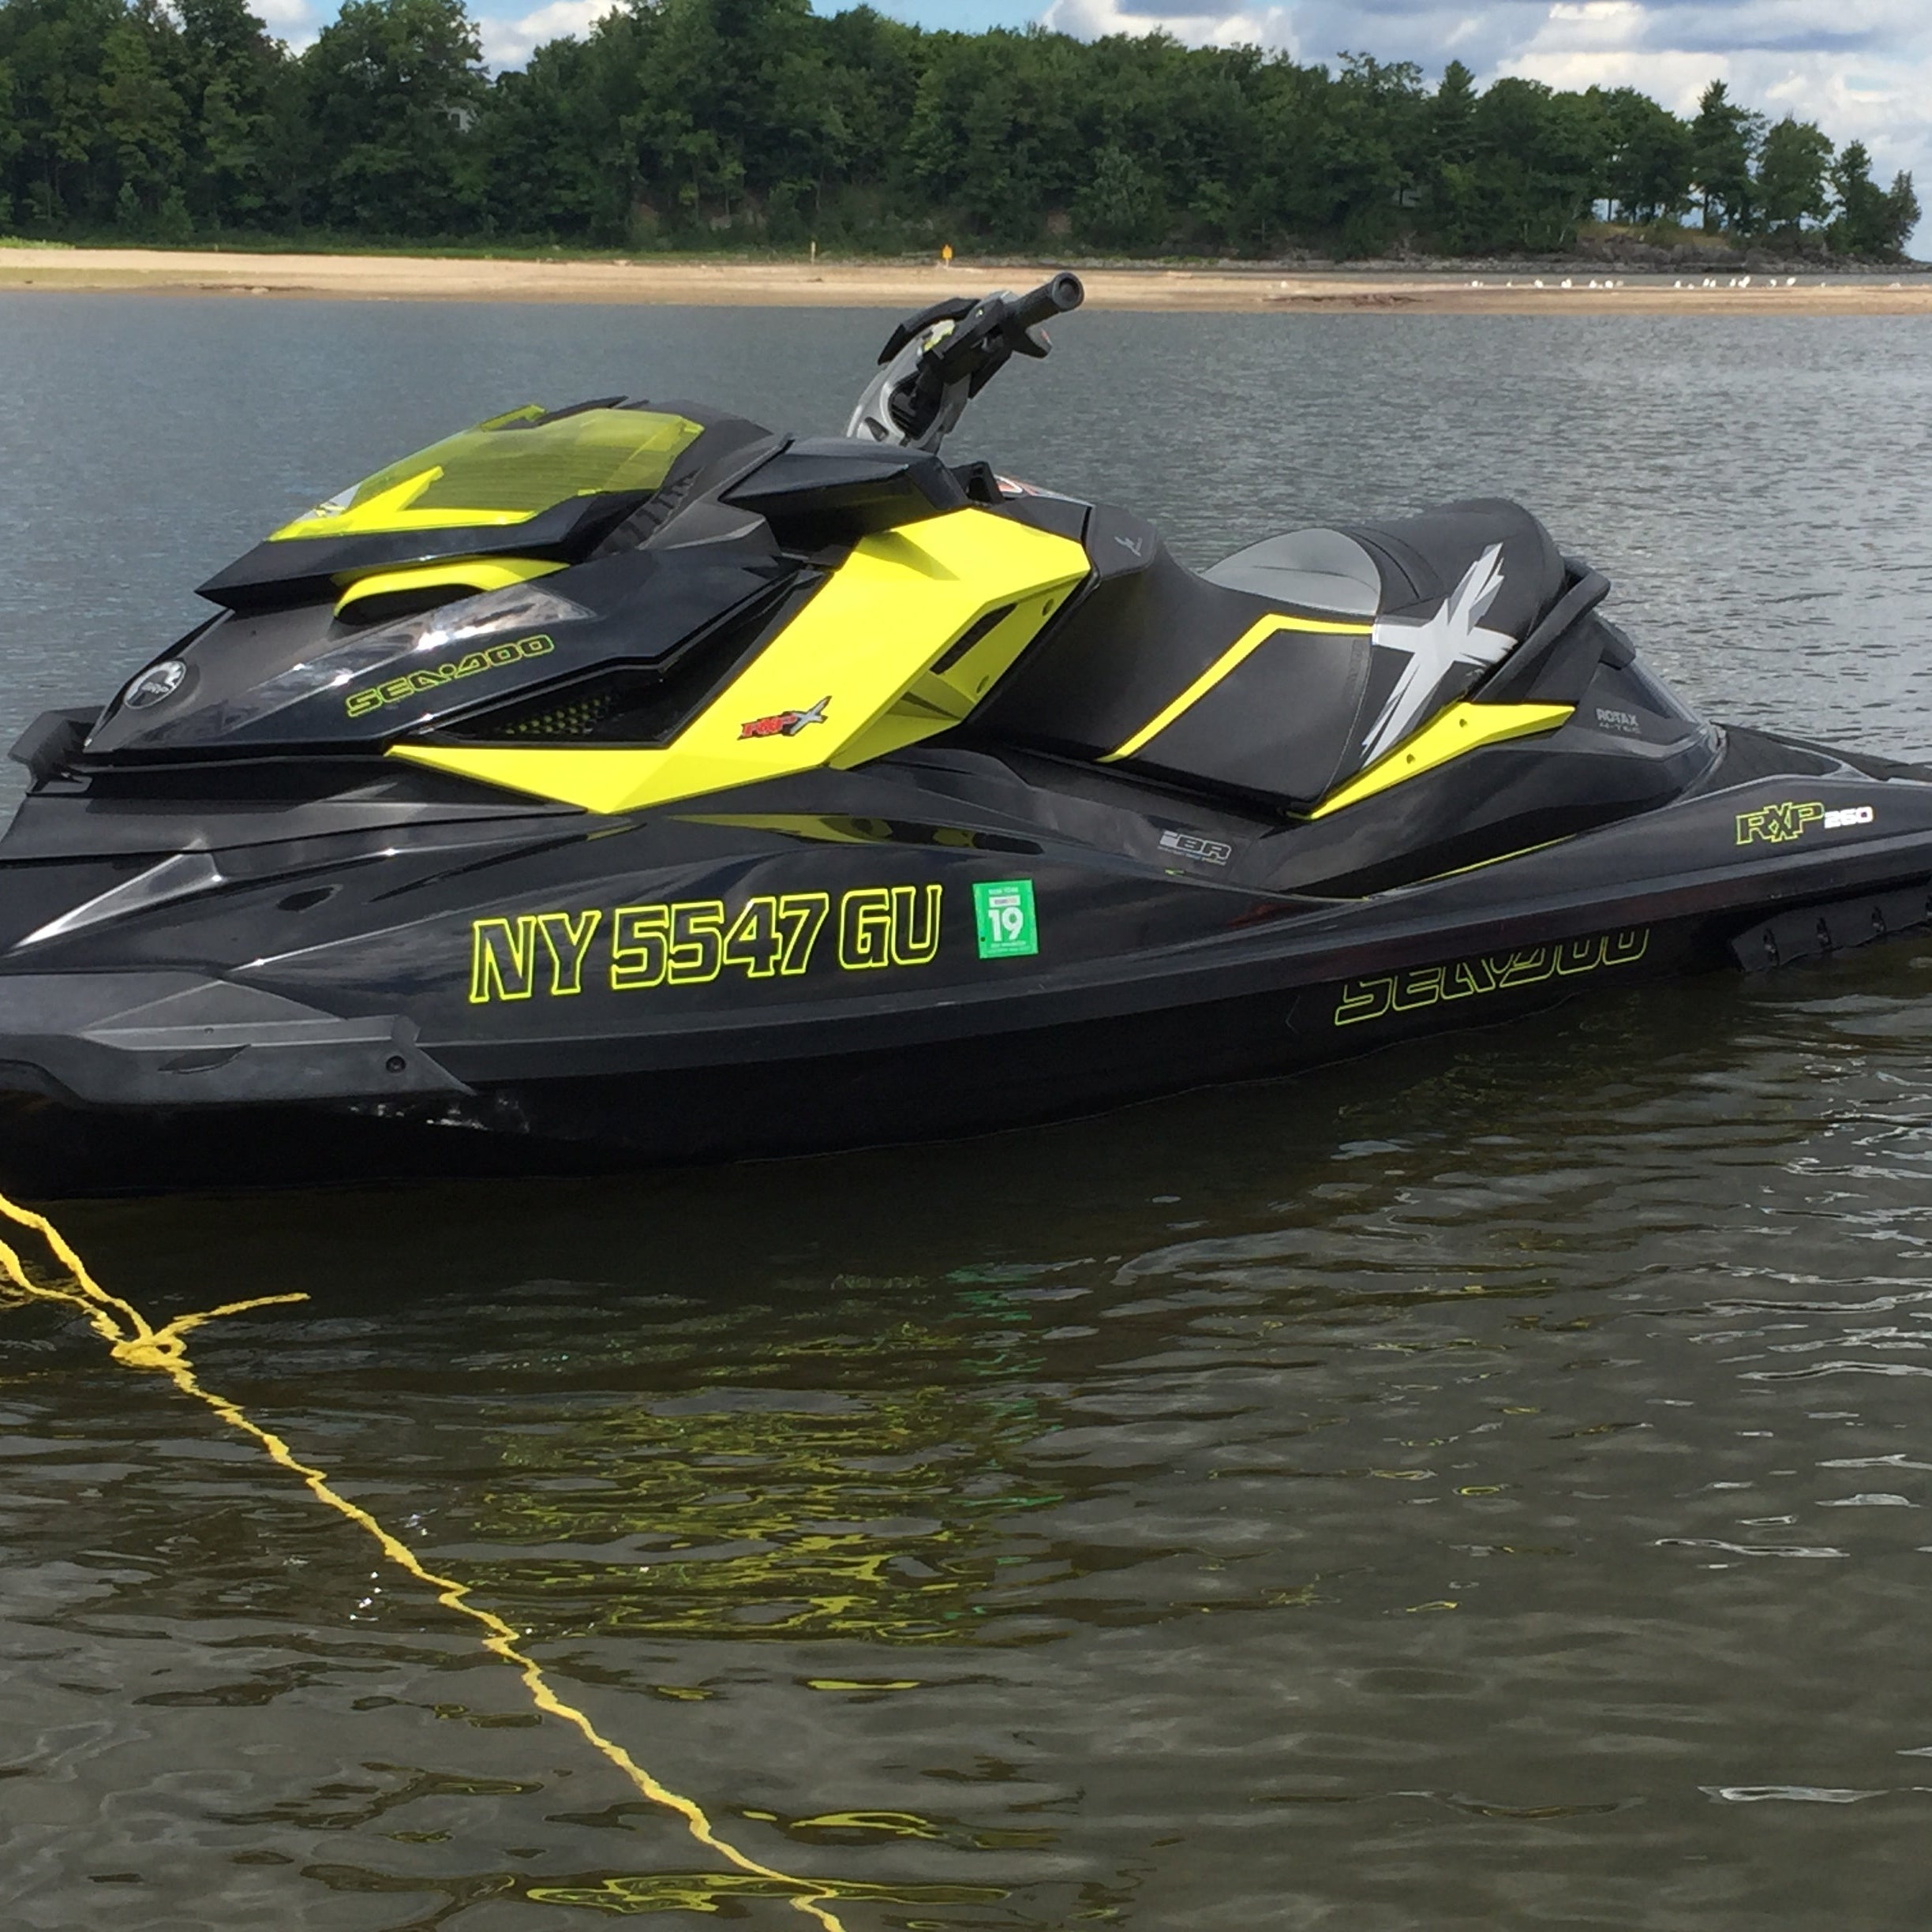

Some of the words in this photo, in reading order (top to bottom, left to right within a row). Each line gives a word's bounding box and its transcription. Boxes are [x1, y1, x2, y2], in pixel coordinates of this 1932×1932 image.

[1596, 708, 1639, 726] ROTAX
[1735, 801, 1825, 845] RXP
[1823, 805, 1874, 829] 260
[987, 906, 1024, 942] 19
[469, 910, 602, 1004] NY
[611, 892, 829, 990] 5547
[838, 885, 942, 969] GU
